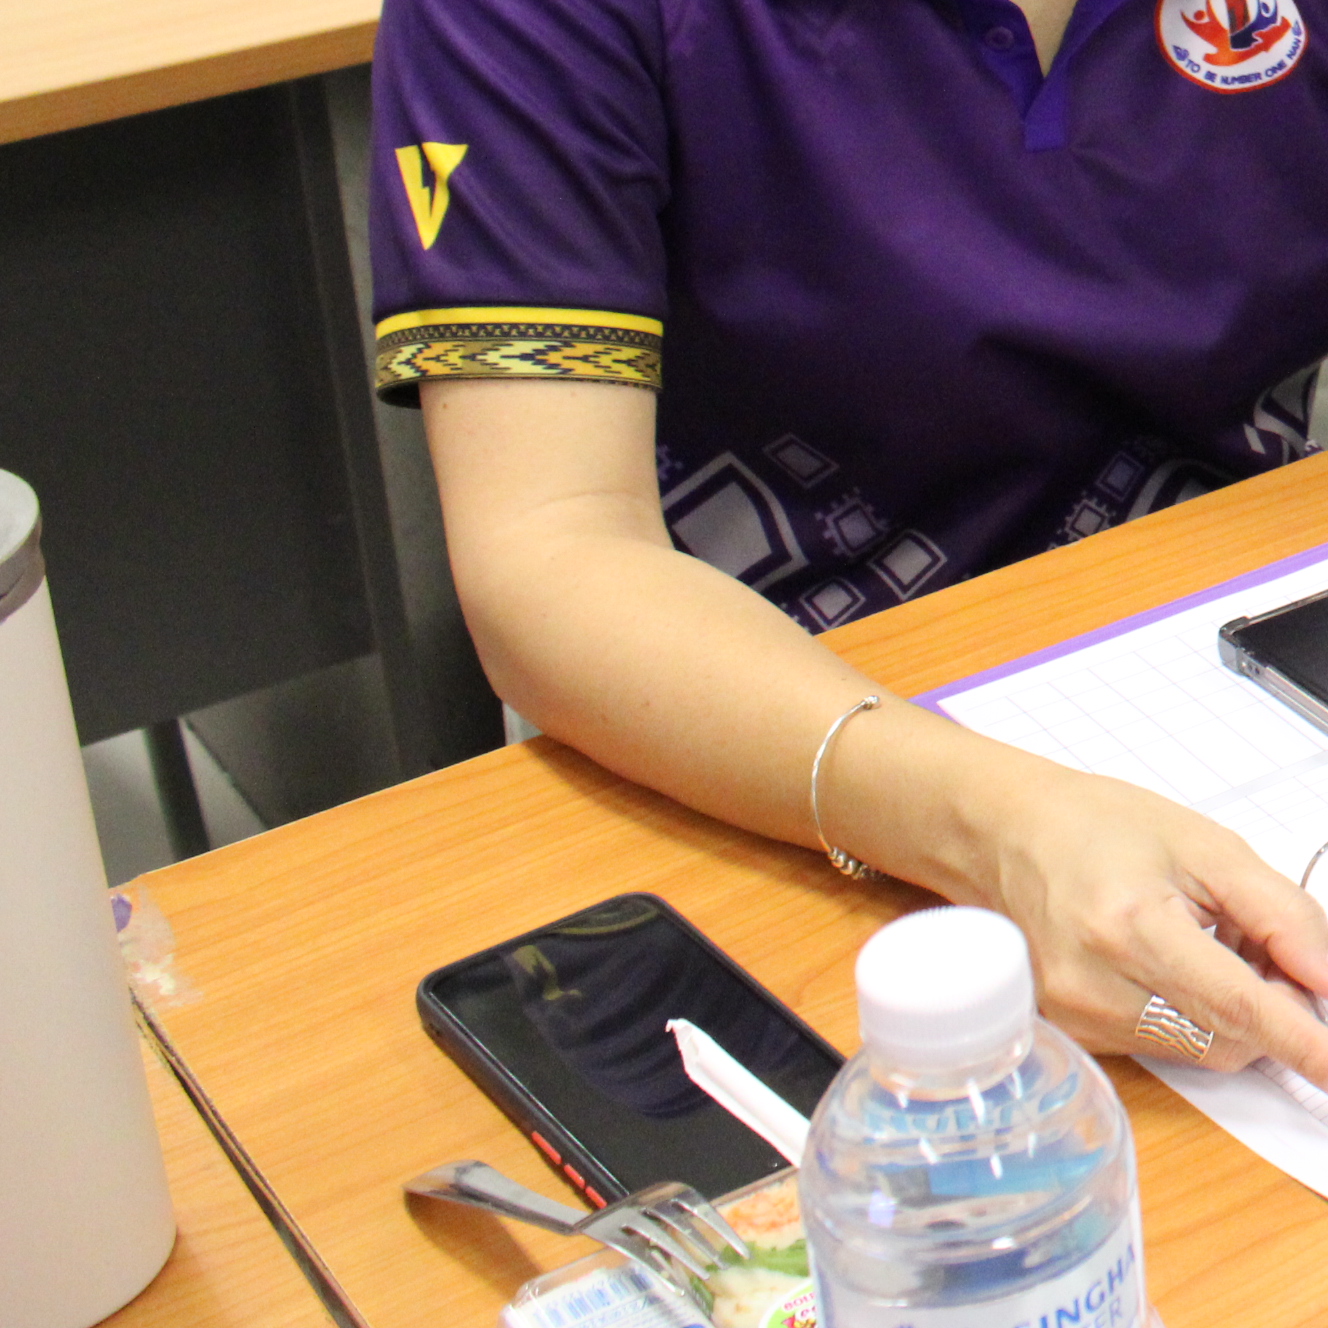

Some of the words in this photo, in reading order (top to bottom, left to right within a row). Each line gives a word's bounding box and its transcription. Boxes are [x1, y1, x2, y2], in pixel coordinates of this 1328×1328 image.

[1185, 59, 1200, 73] TO
[1203, 70, 1217, 83] BE
[1220, 72, 1262, 85] NUMBER
[1265, 60, 1287, 78] ONE
[1013, 1242, 1135, 1328] NGHA
